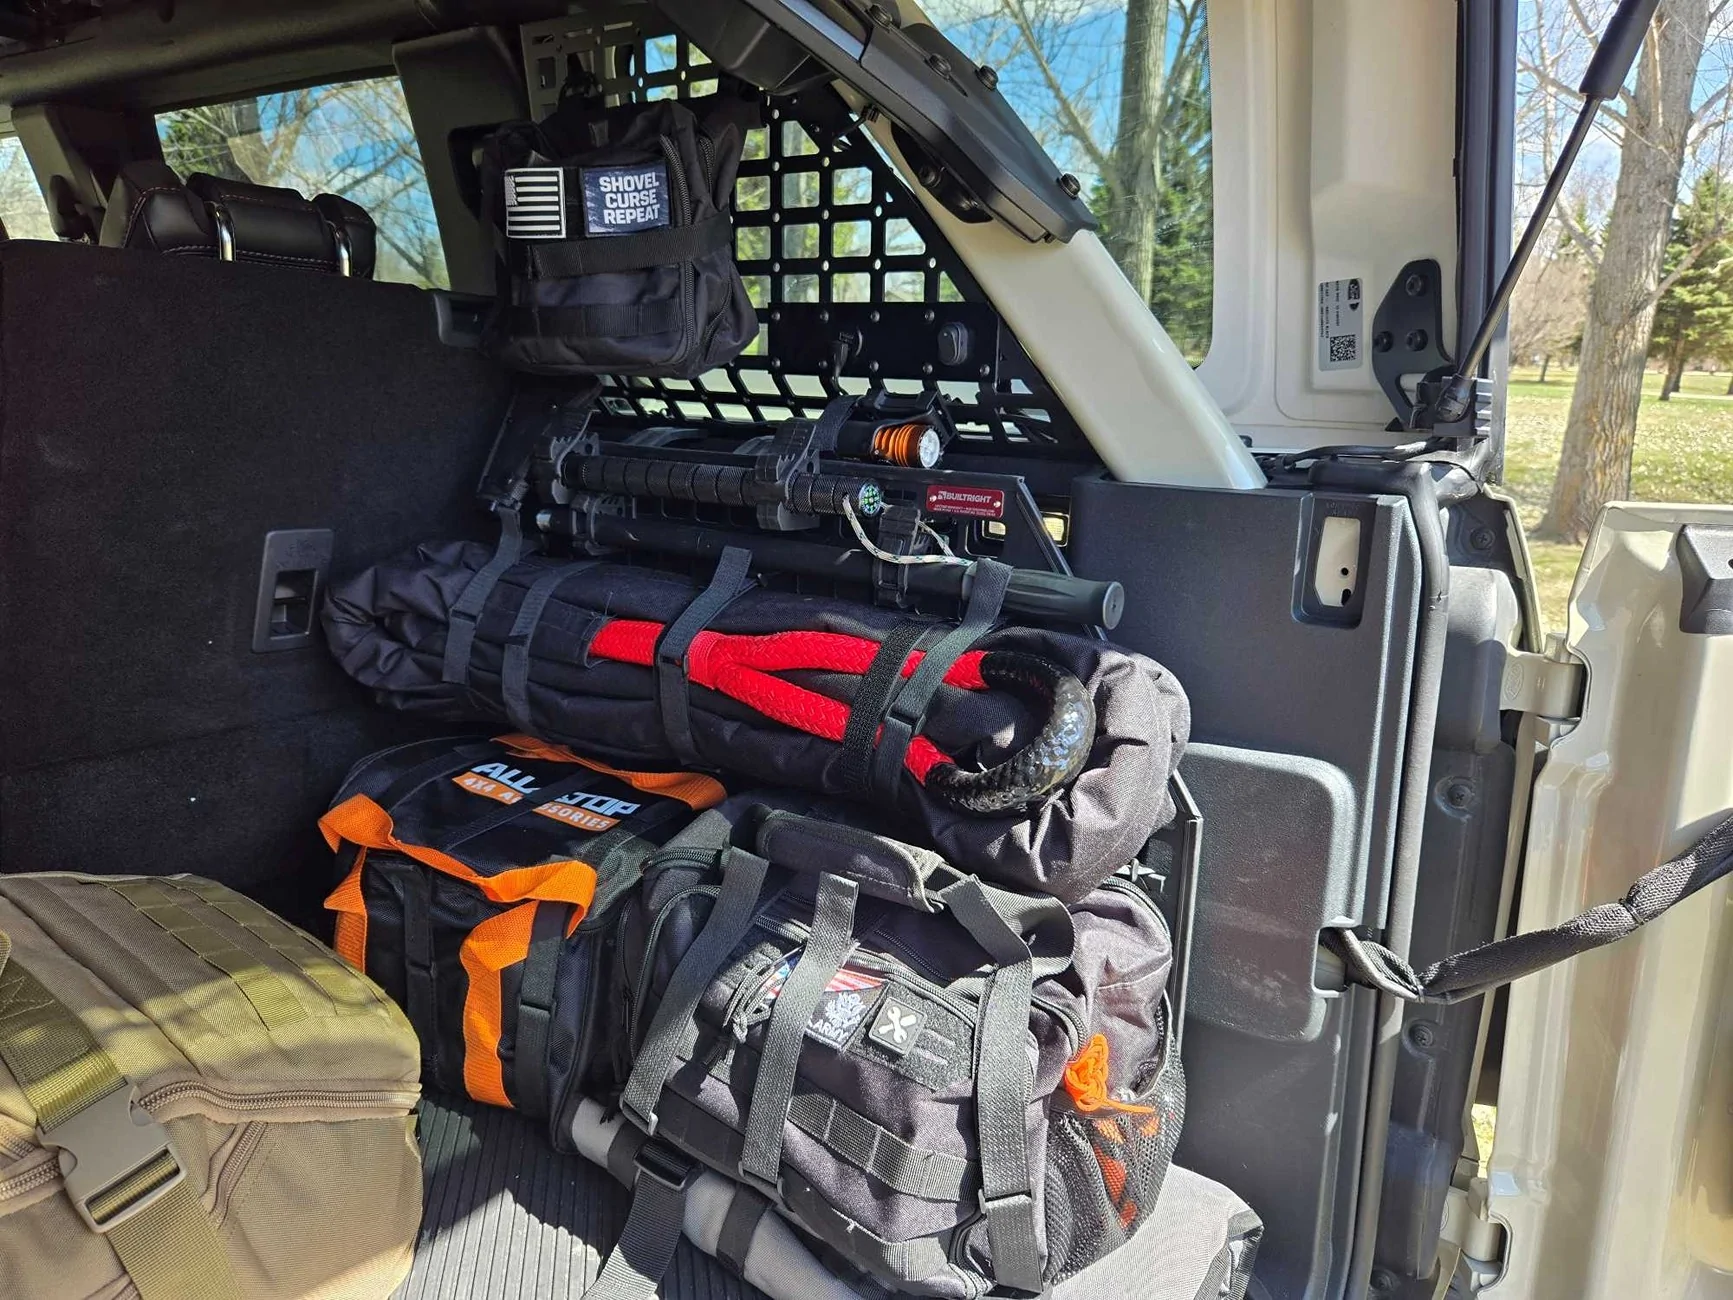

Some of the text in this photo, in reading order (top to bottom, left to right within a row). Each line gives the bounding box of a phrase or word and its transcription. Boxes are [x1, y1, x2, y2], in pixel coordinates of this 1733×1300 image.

[599, 172, 659, 192] SHOVEL
[604, 189, 657, 209] CURSE
[603, 204, 661, 225] REPEAT
[946, 492, 992, 503] BUILTRIGHT
[464, 777, 497, 793] 4X4
